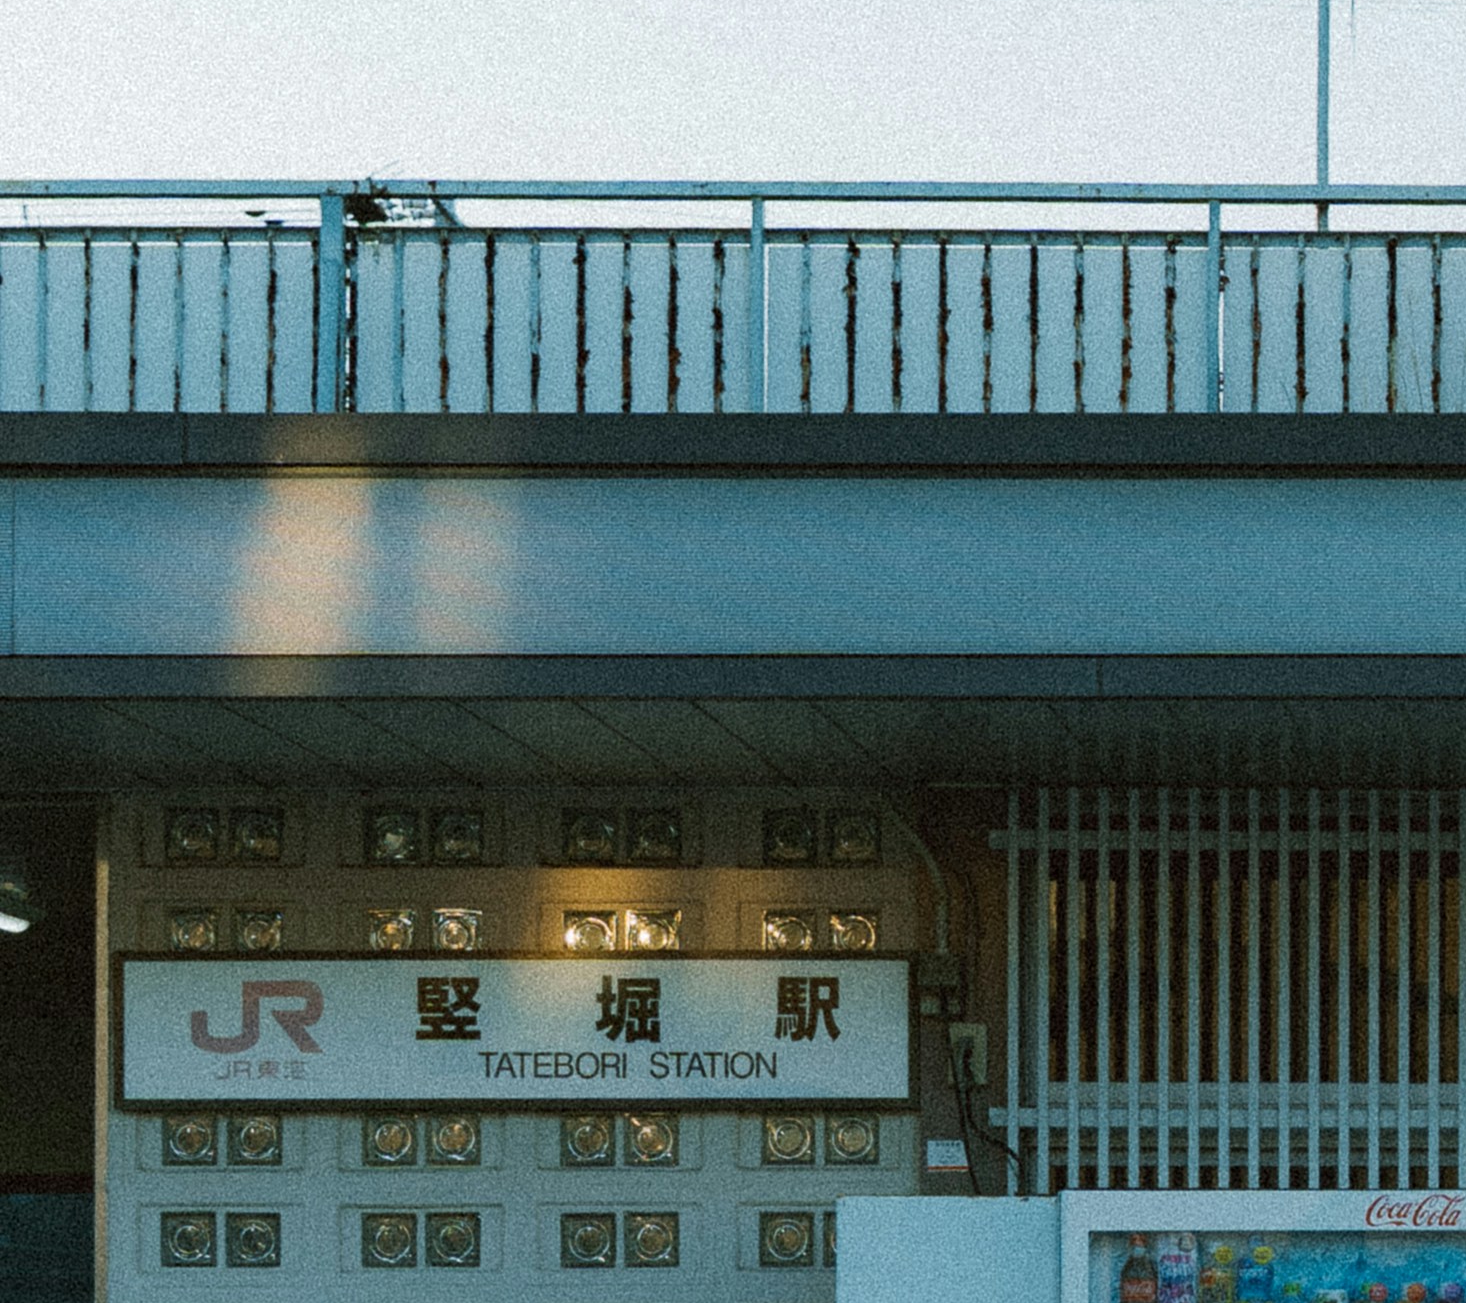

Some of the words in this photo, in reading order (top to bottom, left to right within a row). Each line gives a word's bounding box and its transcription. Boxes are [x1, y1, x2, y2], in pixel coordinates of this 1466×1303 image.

[191, 980, 324, 1054] JR
[215, 1060, 309, 1081] JR東海
[478, 1050, 629, 1080] TATEBORI
[649, 1050, 778, 1080] STATION
